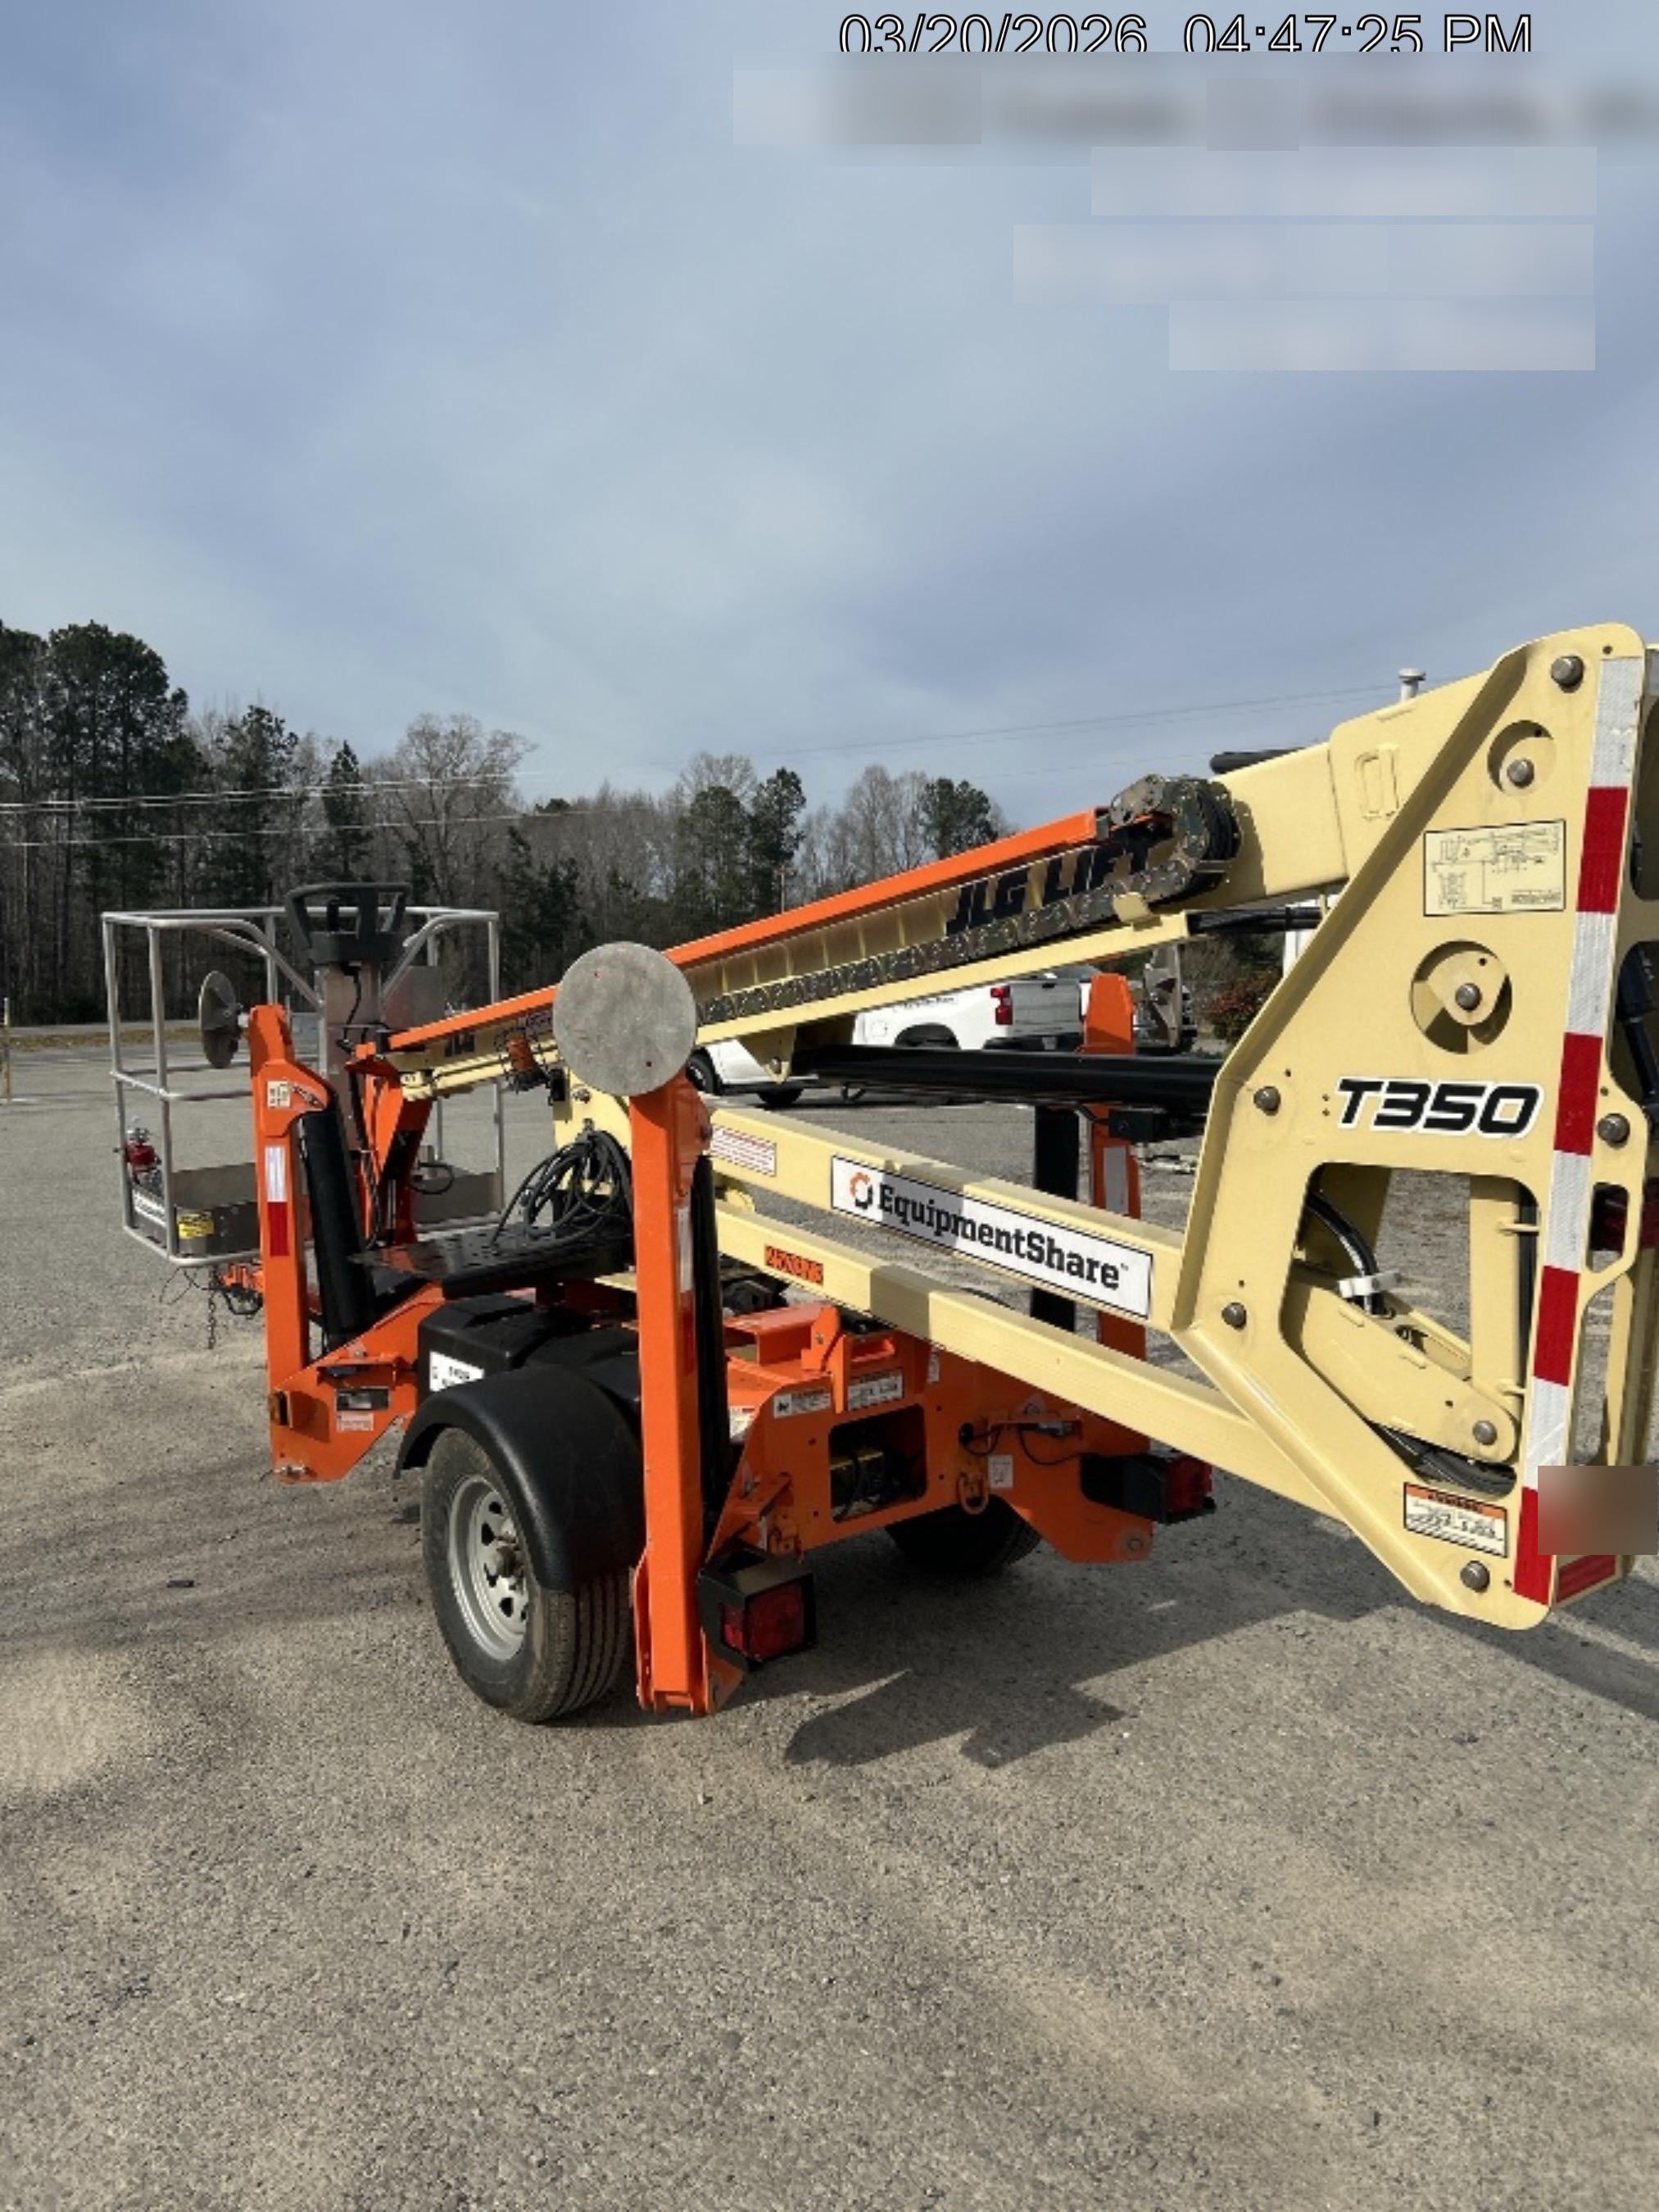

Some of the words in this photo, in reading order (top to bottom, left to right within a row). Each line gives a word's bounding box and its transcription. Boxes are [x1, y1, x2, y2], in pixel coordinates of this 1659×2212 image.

[945, 868, 1027, 934] JLG
[1338, 1078, 1541, 1135] T350
[879, 1183, 1121, 1290] EquipmentShare
